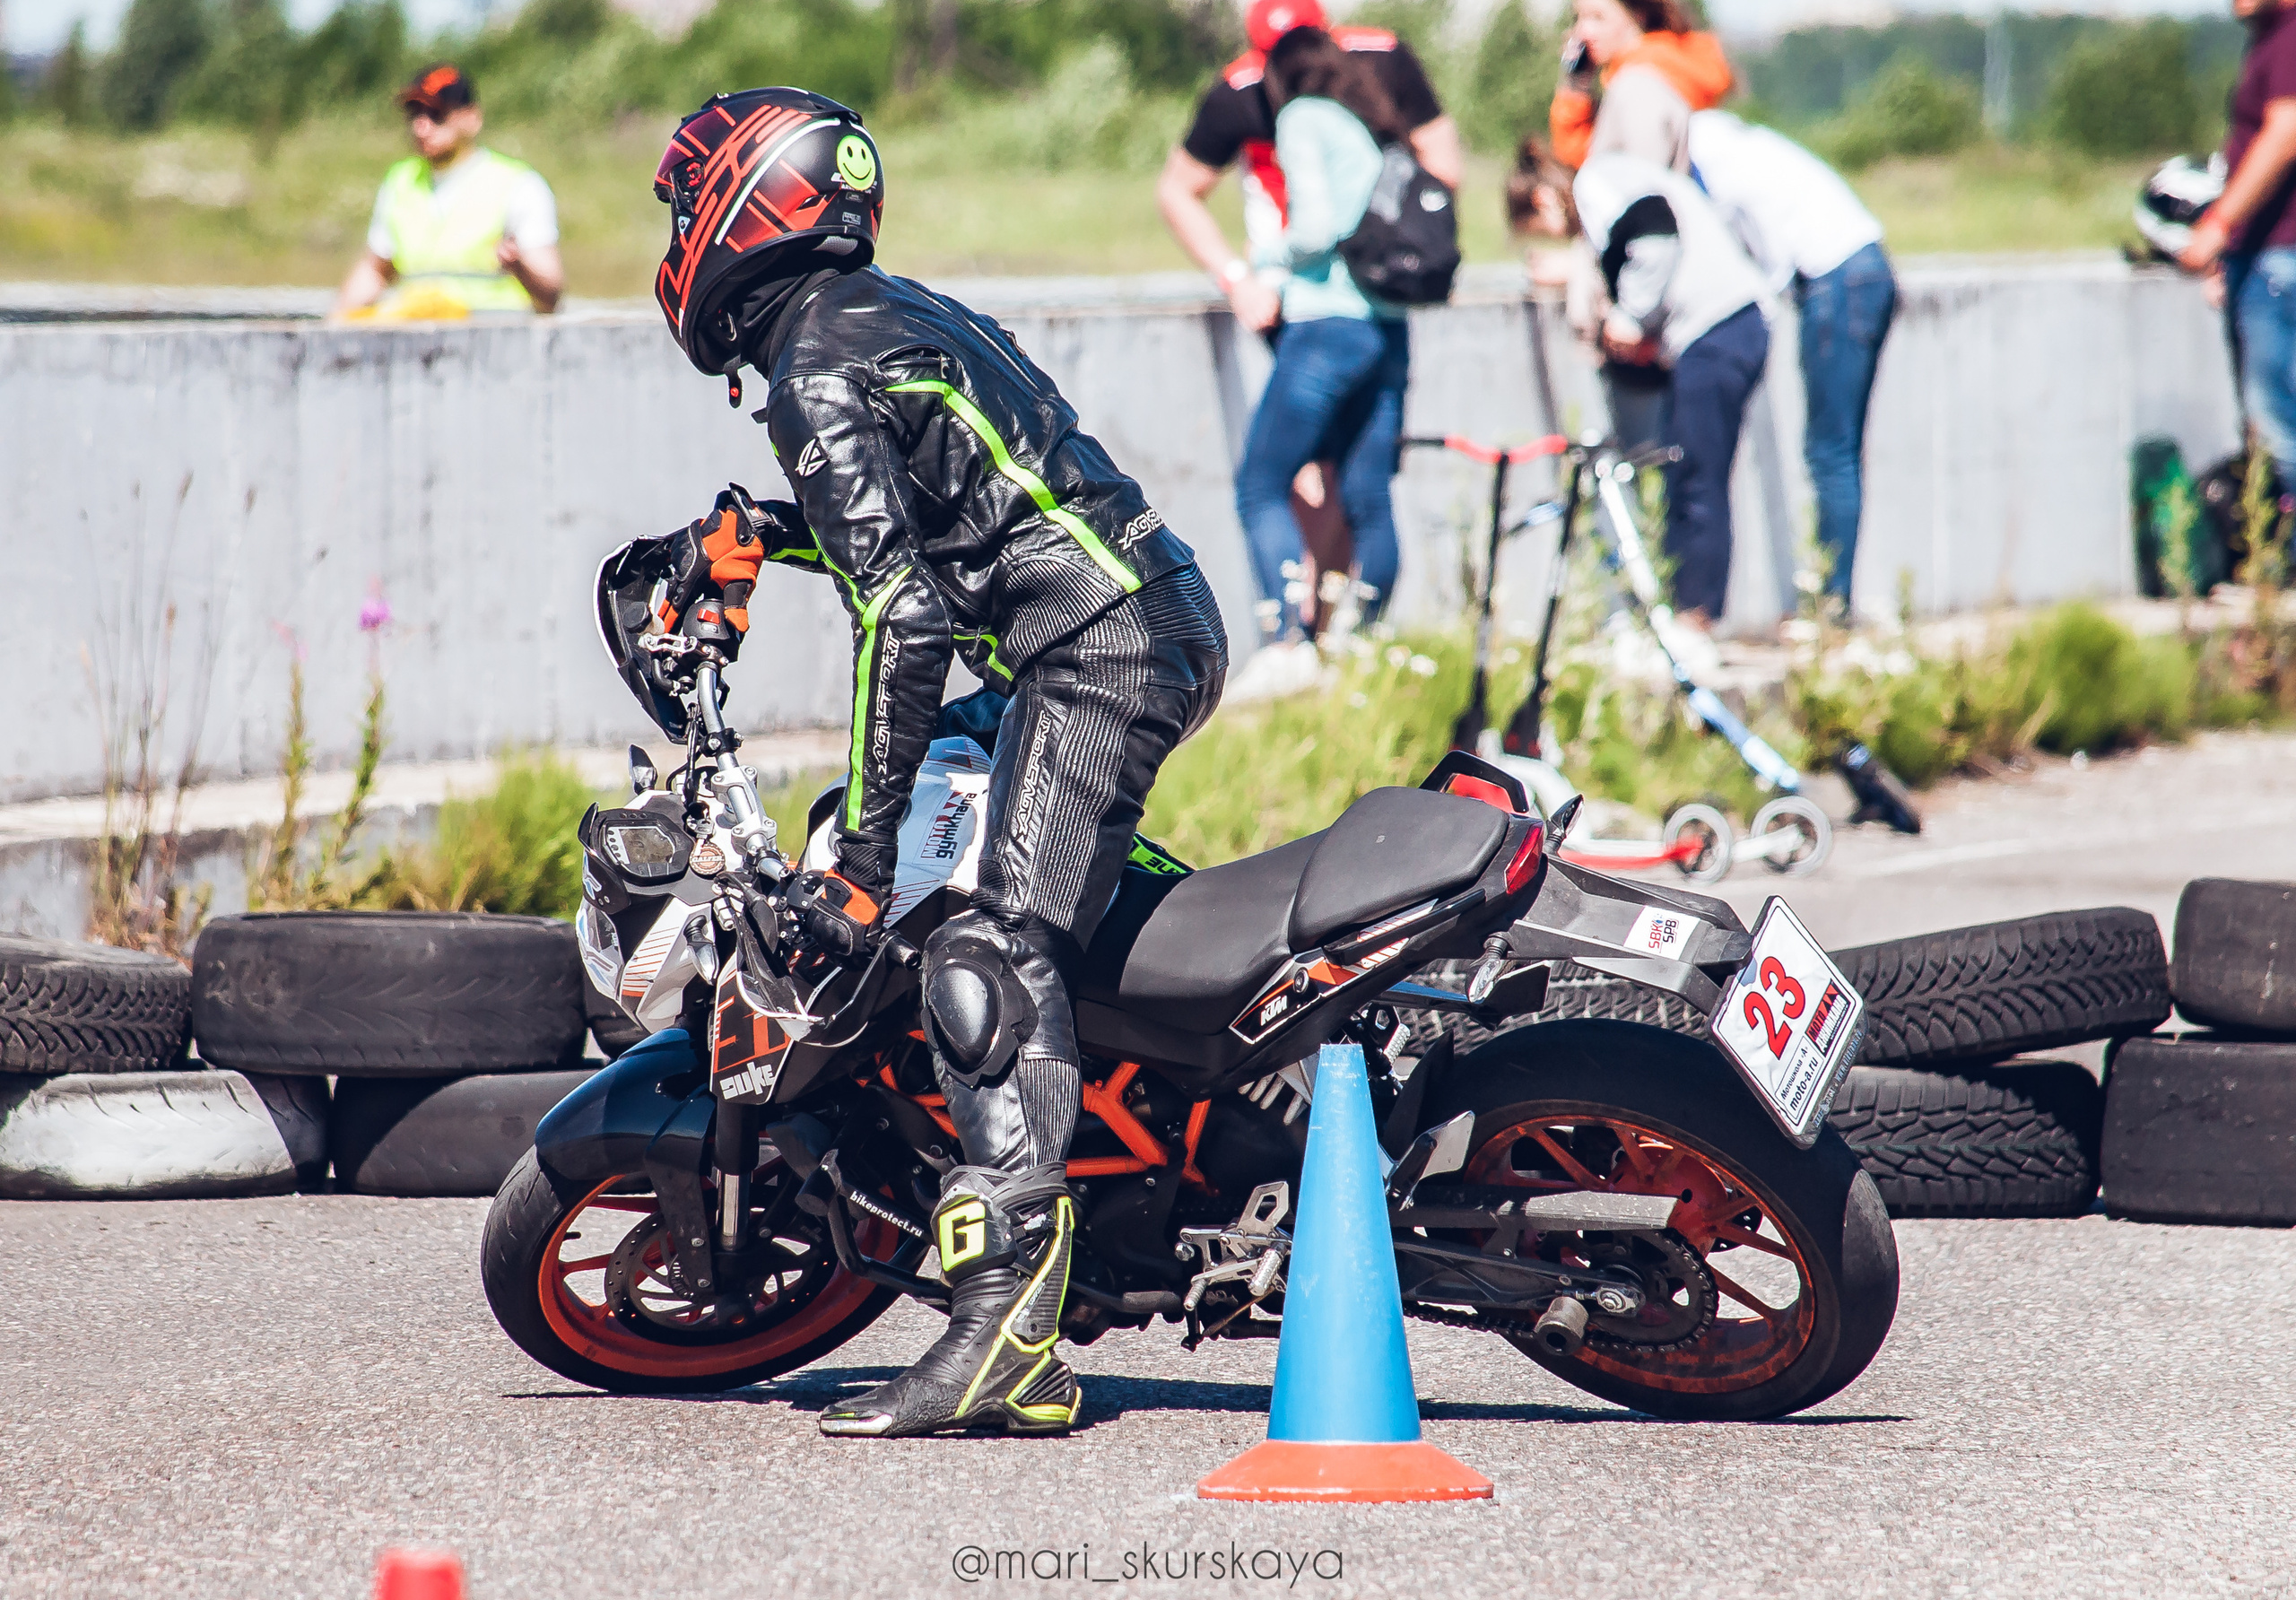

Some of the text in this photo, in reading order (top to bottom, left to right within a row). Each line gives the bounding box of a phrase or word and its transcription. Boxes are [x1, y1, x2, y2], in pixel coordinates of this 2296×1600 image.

[935, 792, 978, 859] gymkhana
[1648, 922, 1664, 949] SBK
[1662, 919, 1677, 943] SPB
[1260, 995, 1288, 1026] KTM
[1744, 956, 1805, 1060] 23
[719, 1061, 776, 1100] DUKE
[1780, 1059, 1804, 1100] Мотошкола
[1789, 1057, 1819, 1111] moto-a.ru
[849, 1190, 923, 1238] bikeprotect.ru
[939, 1200, 986, 1272] G
